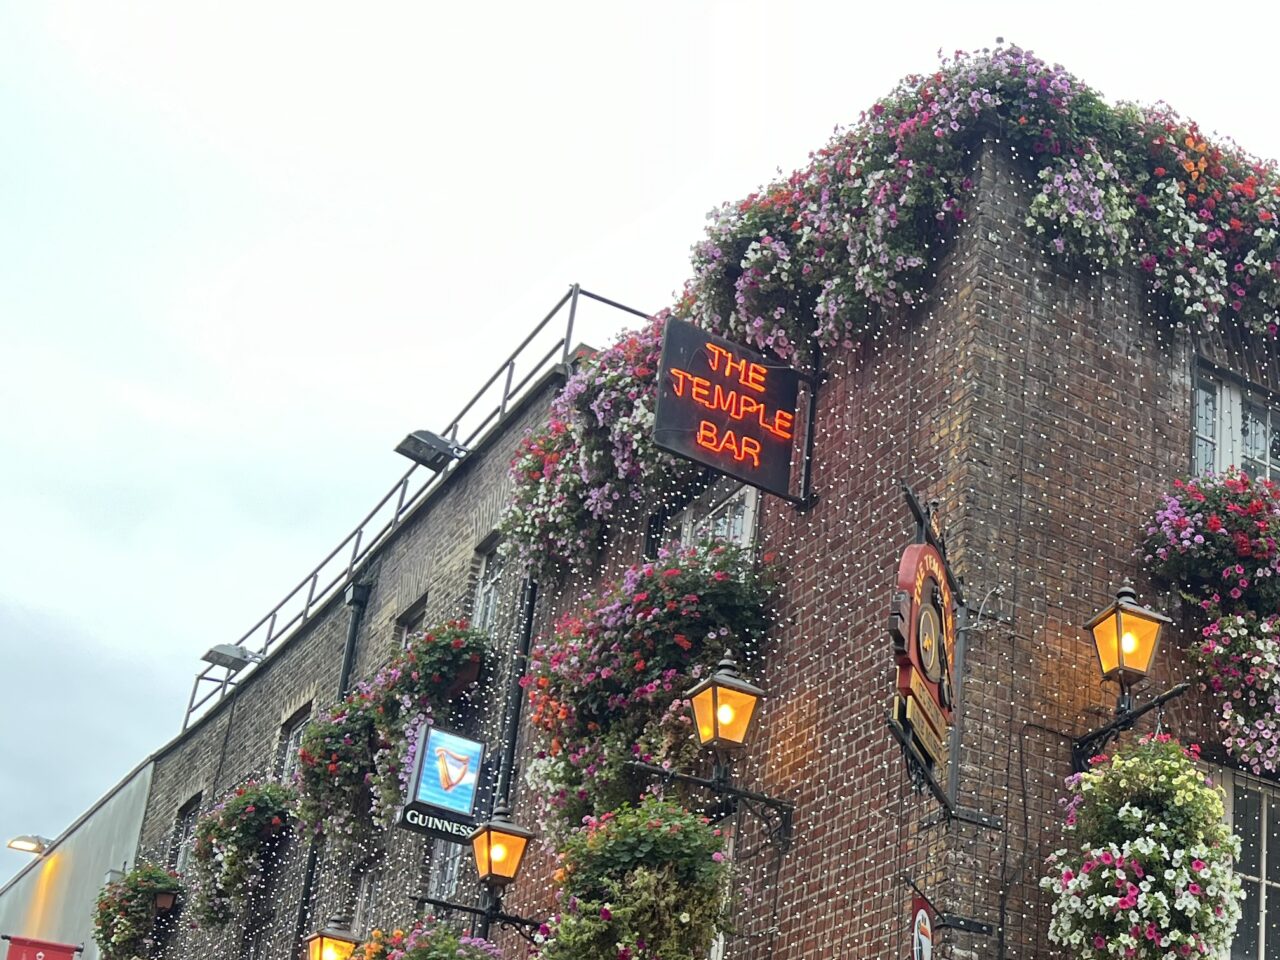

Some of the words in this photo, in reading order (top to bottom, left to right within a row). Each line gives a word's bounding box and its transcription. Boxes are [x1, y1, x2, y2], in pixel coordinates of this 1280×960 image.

[706, 342, 767, 393] THE
[670, 367, 793, 439] TEMPLE
[697, 420, 761, 467] BAR
[406, 809, 474, 837] GUINNESS
